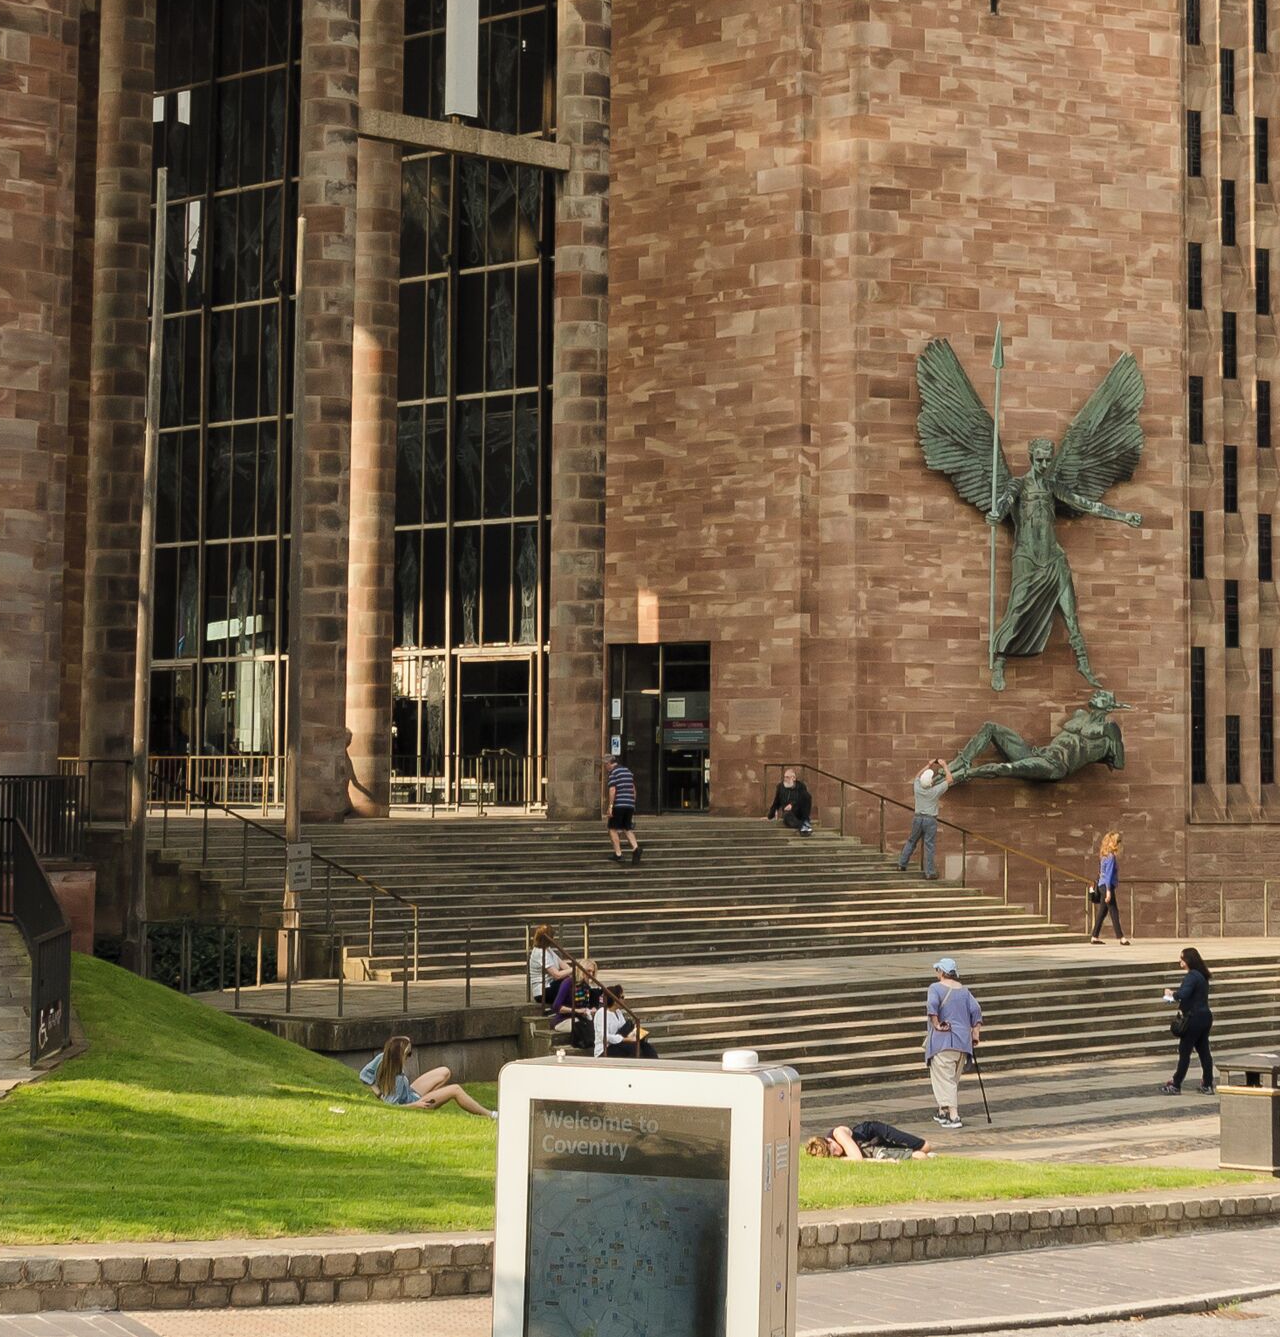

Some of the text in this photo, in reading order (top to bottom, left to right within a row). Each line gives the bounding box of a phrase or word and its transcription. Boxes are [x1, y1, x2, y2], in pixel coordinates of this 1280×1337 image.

[543, 1110, 659, 1134] Welcome to
[542, 1134, 629, 1162] Coventry
